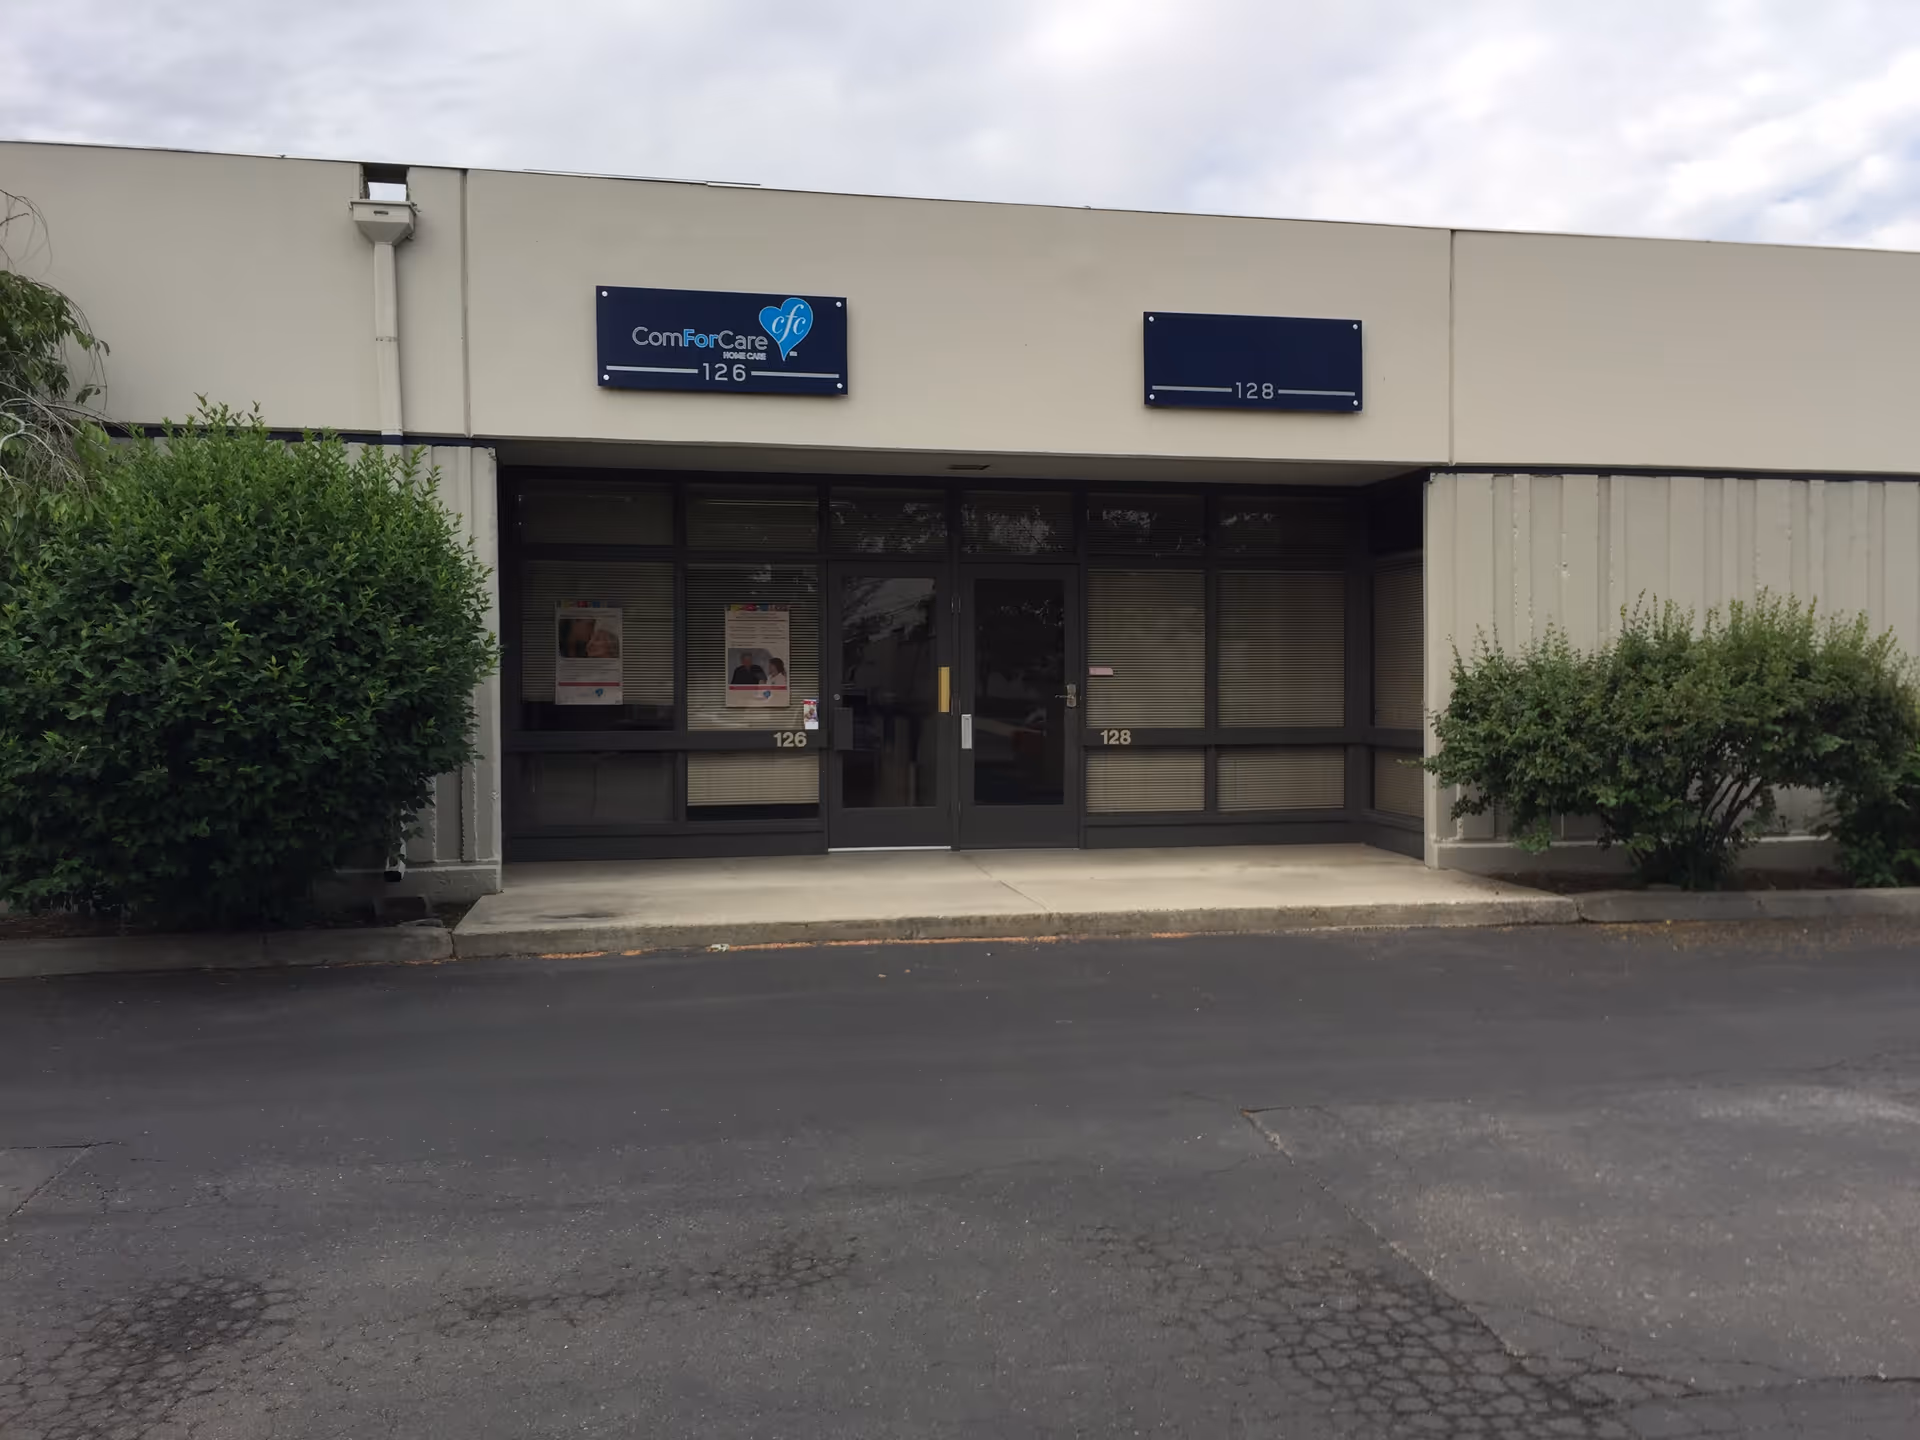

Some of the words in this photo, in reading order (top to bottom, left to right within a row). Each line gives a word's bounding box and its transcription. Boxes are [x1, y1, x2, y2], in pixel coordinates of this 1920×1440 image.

[771, 303, 806, 344] cfc
[631, 326, 769, 351] ComForCare
[722, 351, 746, 360] HOME
[746, 352, 767, 361] CARE
[702, 362, 746, 381] 126
[1235, 381, 1275, 400] 128
[773, 731, 808, 748] 126
[1100, 729, 1132, 745] 128
